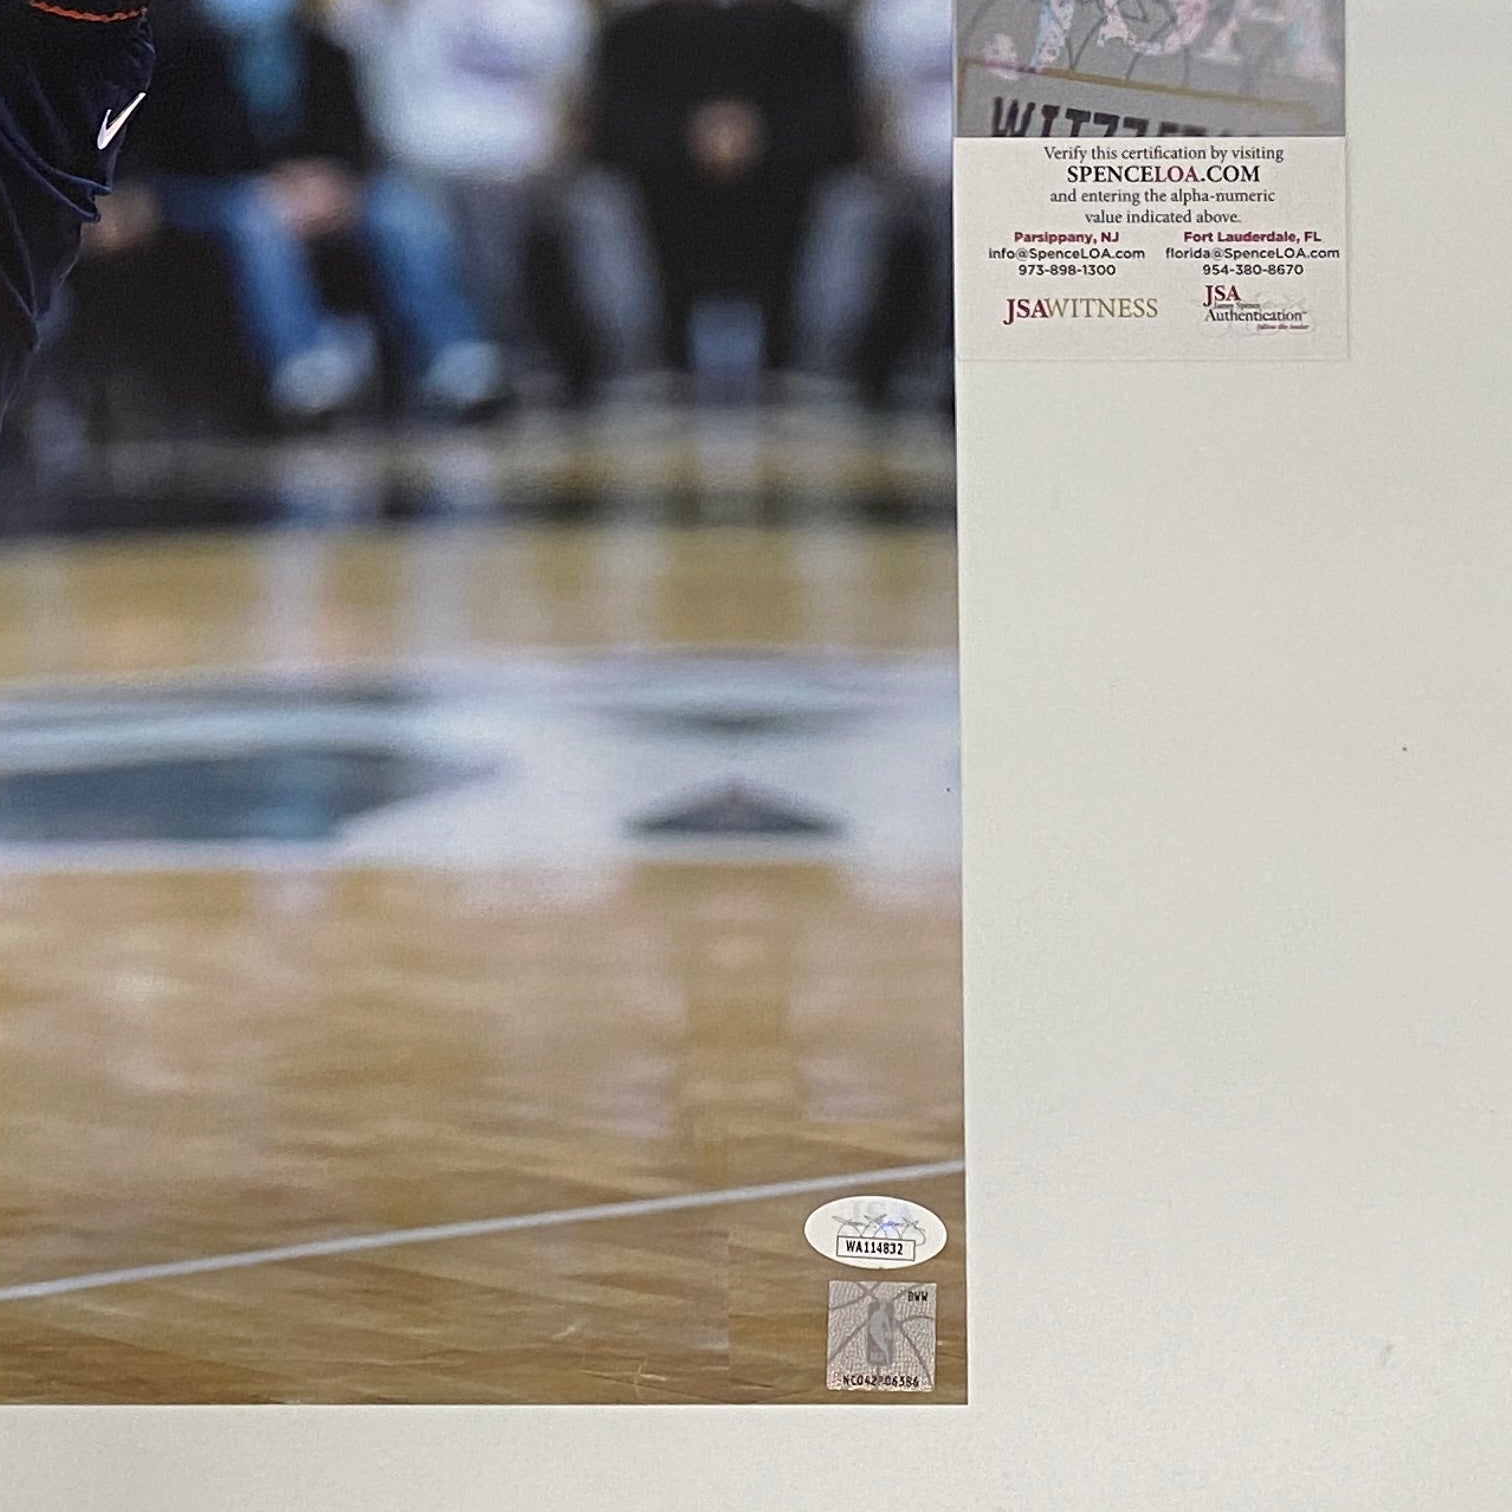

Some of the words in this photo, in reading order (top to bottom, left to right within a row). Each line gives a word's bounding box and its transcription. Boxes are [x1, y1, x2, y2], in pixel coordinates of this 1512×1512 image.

[1044, 146, 1087, 163] Verify
[1091, 145, 1118, 160] this
[1121, 145, 1206, 160] certification
[1210, 145, 1228, 163] by
[1232, 145, 1284, 162] visiting
[1067, 165, 1260, 183] SPENCELOA.COM
[1050, 188, 1077, 202] and
[1081, 188, 1140, 206] entering
[1144, 188, 1167, 202] the
[1170, 188, 1276, 206] alpha-numeric
[1085, 210, 1122, 223] value
[1126, 209, 1192, 223] indicated
[1196, 209, 1241, 223] above.
[1014, 231, 1097, 245] Parsippany,
[1101, 231, 1119, 243] NJ
[1184, 231, 1213, 243] Fort
[1217, 231, 1300, 244] Lauderdale,
[1304, 231, 1322, 242] FL
[989, 248, 1145, 261] info@SpenceLOA.com
[1165, 247, 1340, 261] florida@SpenceLOA.com
[1018, 264, 1117, 276] 973-898-1300
[1203, 264, 1304, 275] 954-380-8670
[1203, 285, 1242, 307] JSA
[846, 1239, 903, 1256] WA114832
